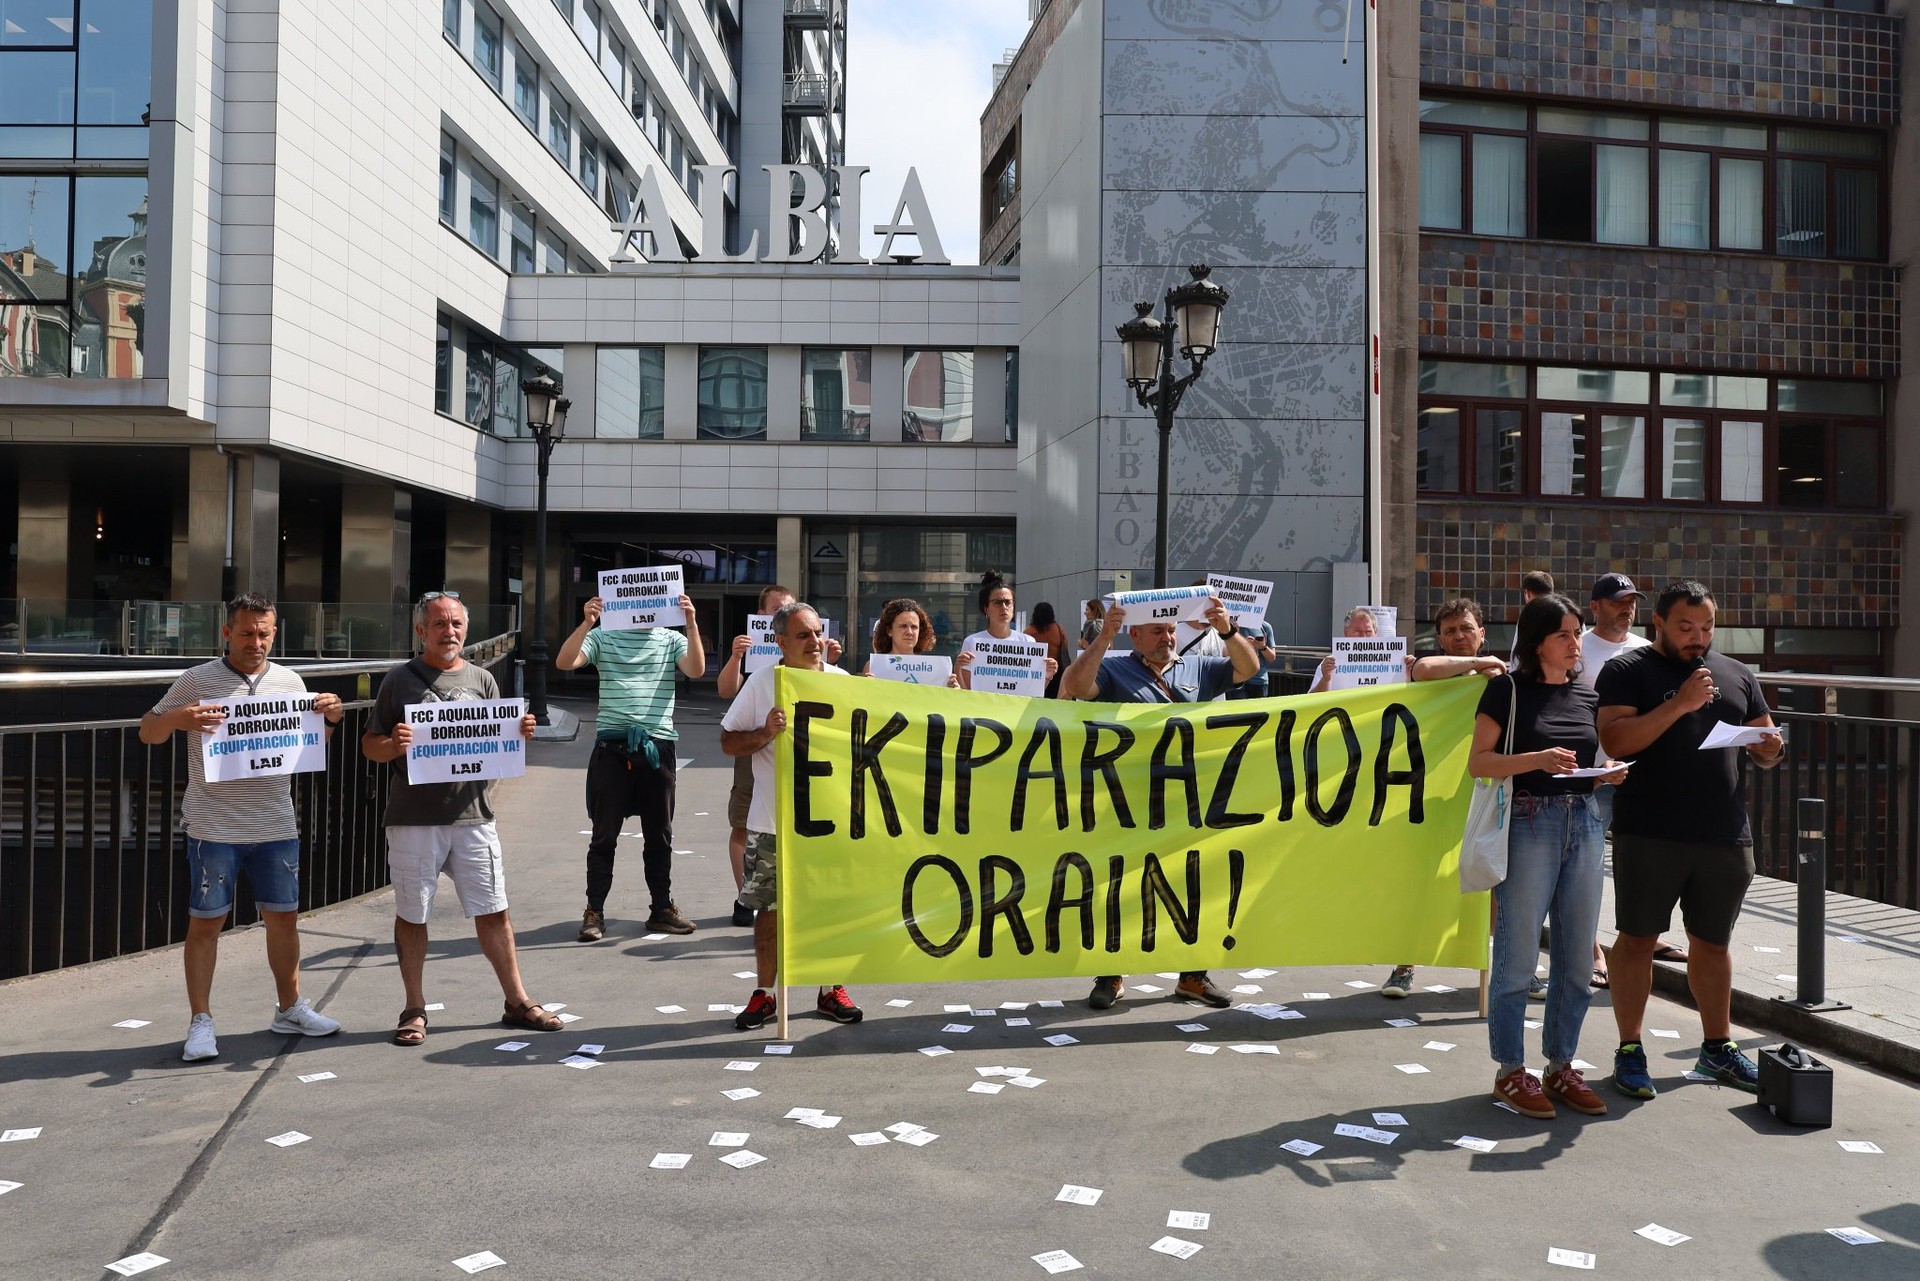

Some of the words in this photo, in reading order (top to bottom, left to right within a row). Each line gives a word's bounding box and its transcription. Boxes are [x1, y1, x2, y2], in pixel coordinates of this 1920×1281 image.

[609, 163, 951, 265] ALBIA
[1113, 353, 1140, 546] ILBAO
[602, 575, 618, 586] FCC
[621, 572, 659, 584] AQUALIA
[661, 571, 679, 582] LOIU
[616, 585, 668, 598] BORROKAN!
[1194, 587, 1210, 597] YA!
[1209, 578, 1223, 588] FCC
[1224, 580, 1253, 593] AQUALIA
[1254, 584, 1270, 595] LOIU
[603, 597, 667, 612] ¡EQUIPARACIÓN
[1218, 590, 1257, 604] BORROKAN!
[632, 613, 656, 624] LAB
[1152, 605, 1179, 618] LAB
[751, 620, 767, 630] FCC
[975, 642, 991, 652] FCC
[992, 643, 1025, 655] AQUALIA
[1026, 646, 1044, 657] LOIU
[1336, 642, 1351, 651] FCC
[1352, 641, 1384, 651] AQUALIA
[1386, 641, 1403, 651] LOIU
[986, 655, 1031, 668] BORROKAN!
[1347, 653, 1391, 663] BORROKAN!
[895, 661, 933, 674] aqualia
[973, 666, 1029, 679] ¡EQUIPARACIÓN
[1031, 670, 1042, 680] YA!
[1335, 663, 1389, 674] ¡EQUIPARACIÓN
[1391, 664, 1402, 673] YA!
[996, 681, 1018, 691] LAB
[234, 701, 288, 718] AQUALIA
[411, 709, 434, 724] FCC
[438, 707, 489, 722] AQUALIA
[492, 705, 519, 719] LOIU
[227, 716, 301, 736] BORROKAN!
[431, 723, 501, 740] BORROKAN!
[208, 732, 298, 758] ¡EQUIPARACIÓN
[302, 732, 319, 746] YA!
[412, 739, 498, 760] ¡EQUIPARACIÓN
[502, 740, 520, 753] YA!
[250, 754, 284, 770] LAB
[451, 760, 483, 775] LAB
[793, 700, 1425, 840] EKIPARAZIOA
[901, 849, 1245, 958] ORAIN!
